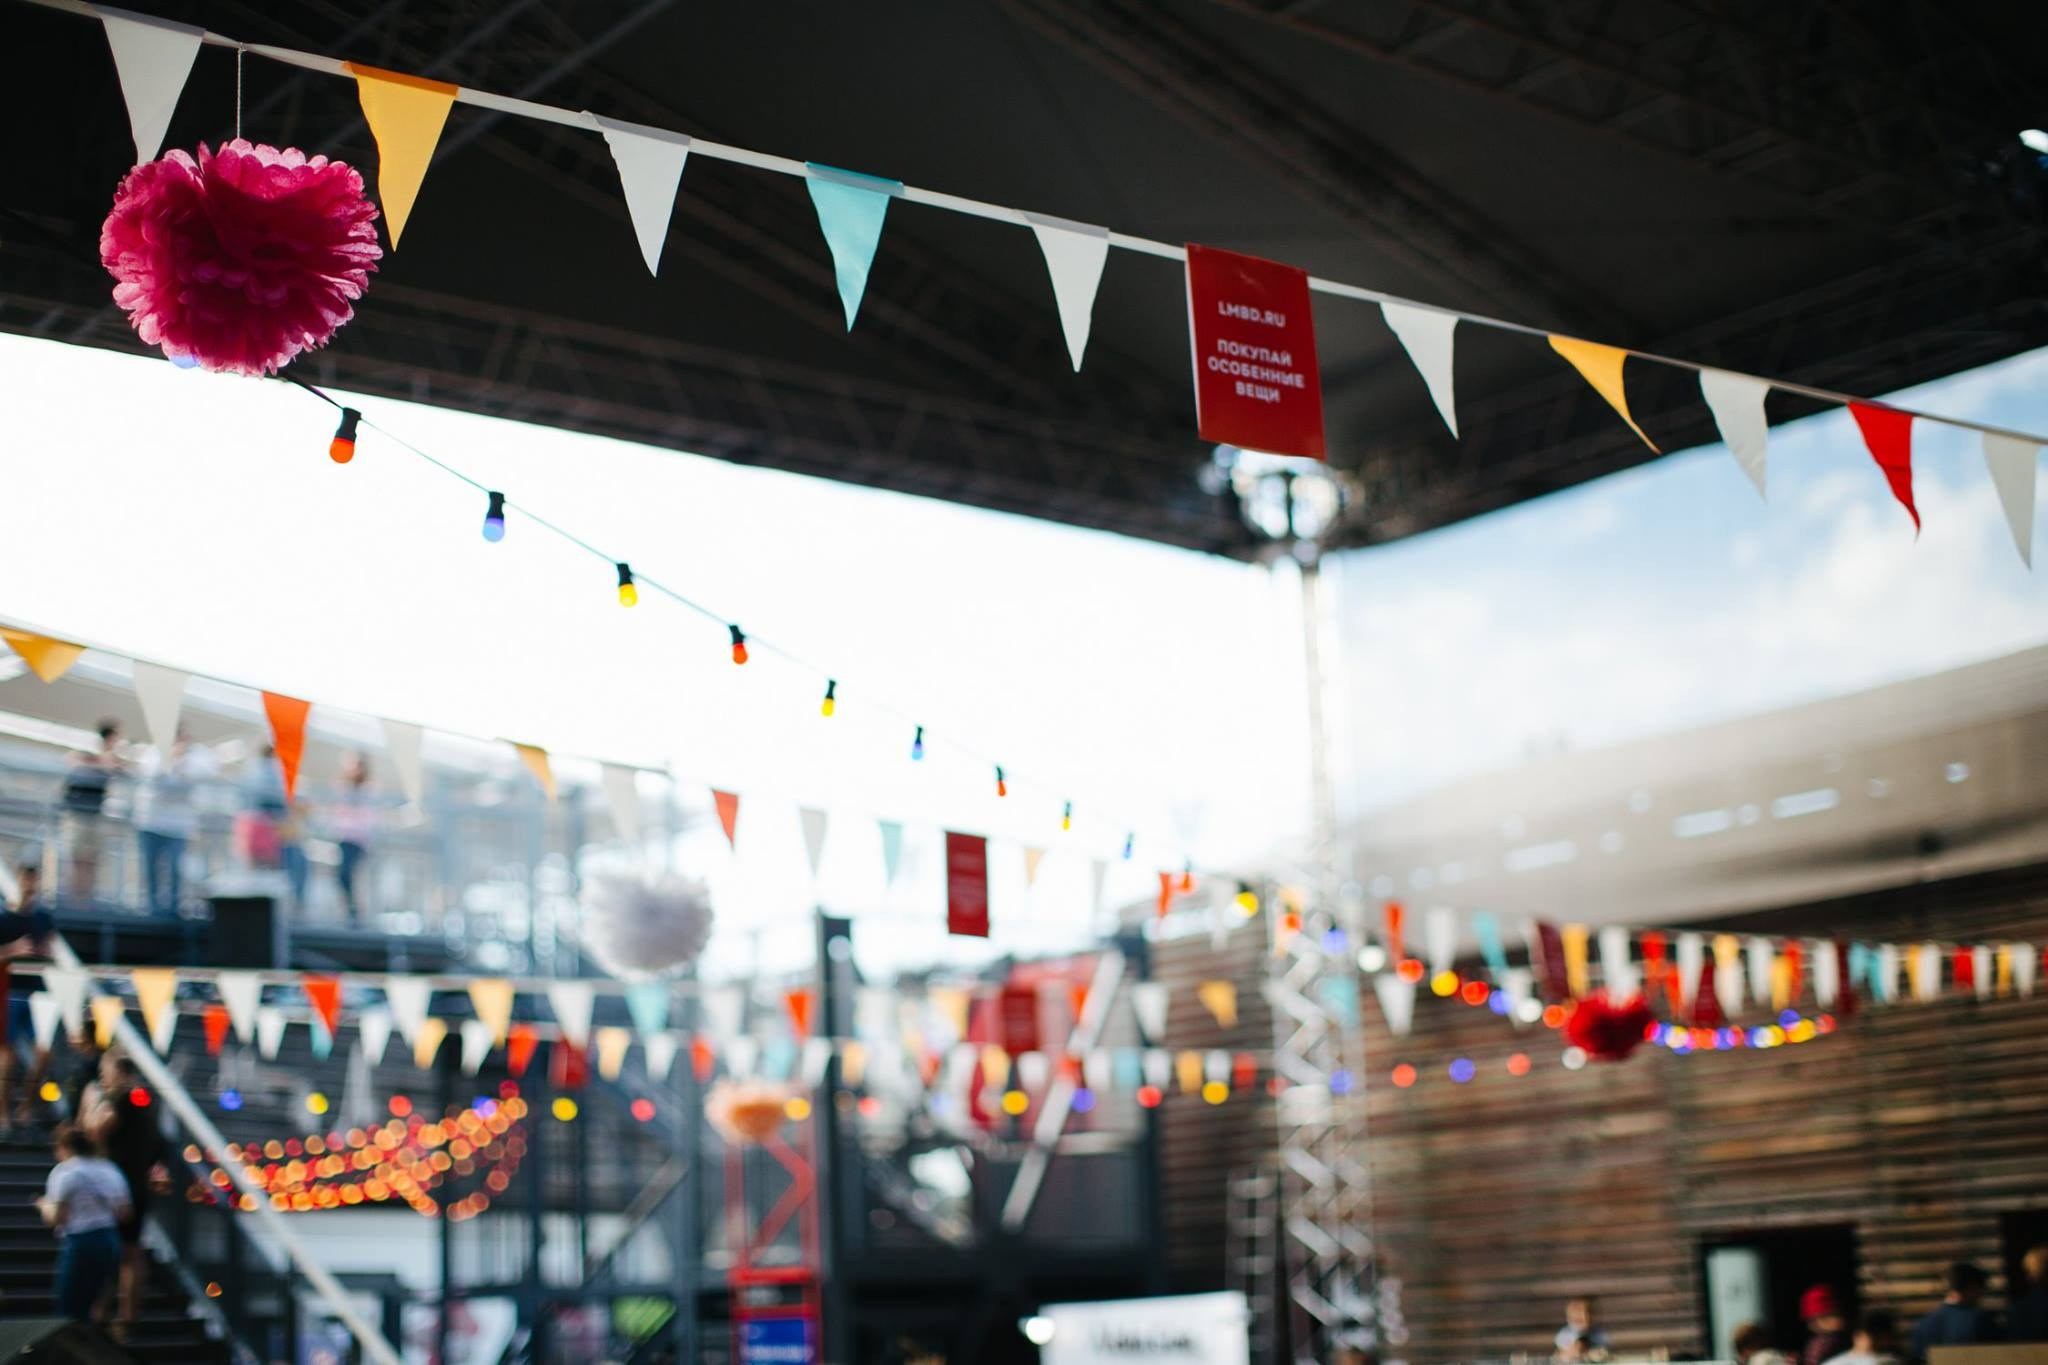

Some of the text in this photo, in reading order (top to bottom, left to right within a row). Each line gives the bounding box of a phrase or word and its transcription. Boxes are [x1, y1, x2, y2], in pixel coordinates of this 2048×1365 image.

[1217, 301, 1285, 327] LMBD.RU
[1217, 339, 1292, 366] ПОКУПАЙ
[1207, 356, 1305, 388] ОСОБЕННЫЕ
[1235, 381, 1280, 402] ВЕЩИ
